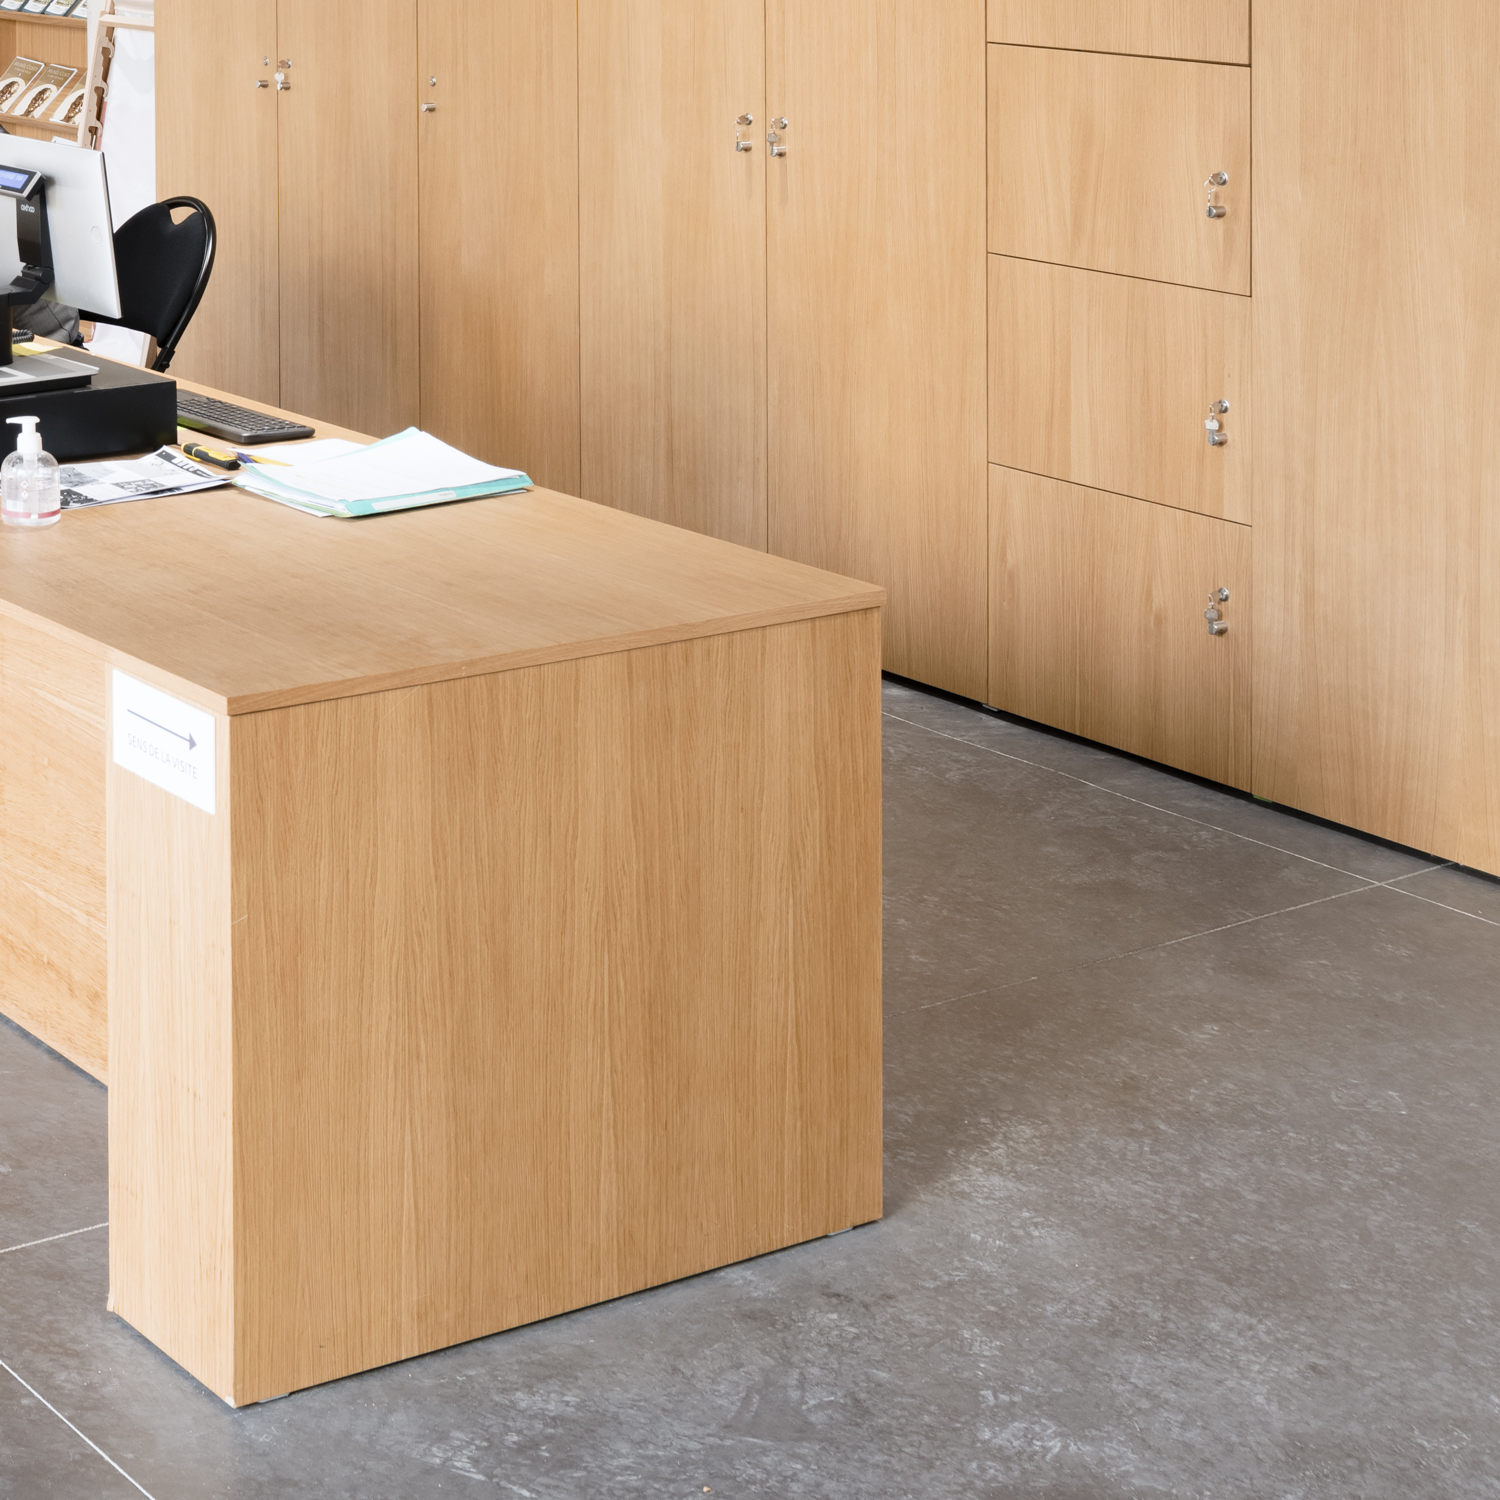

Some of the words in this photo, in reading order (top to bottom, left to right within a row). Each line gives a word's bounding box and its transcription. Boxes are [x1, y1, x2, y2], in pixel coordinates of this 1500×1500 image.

[127, 732, 148, 753] SENS
[149, 743, 159, 760] DE
[161, 750, 171, 765] LA
[172, 756, 198, 780] VISITE
